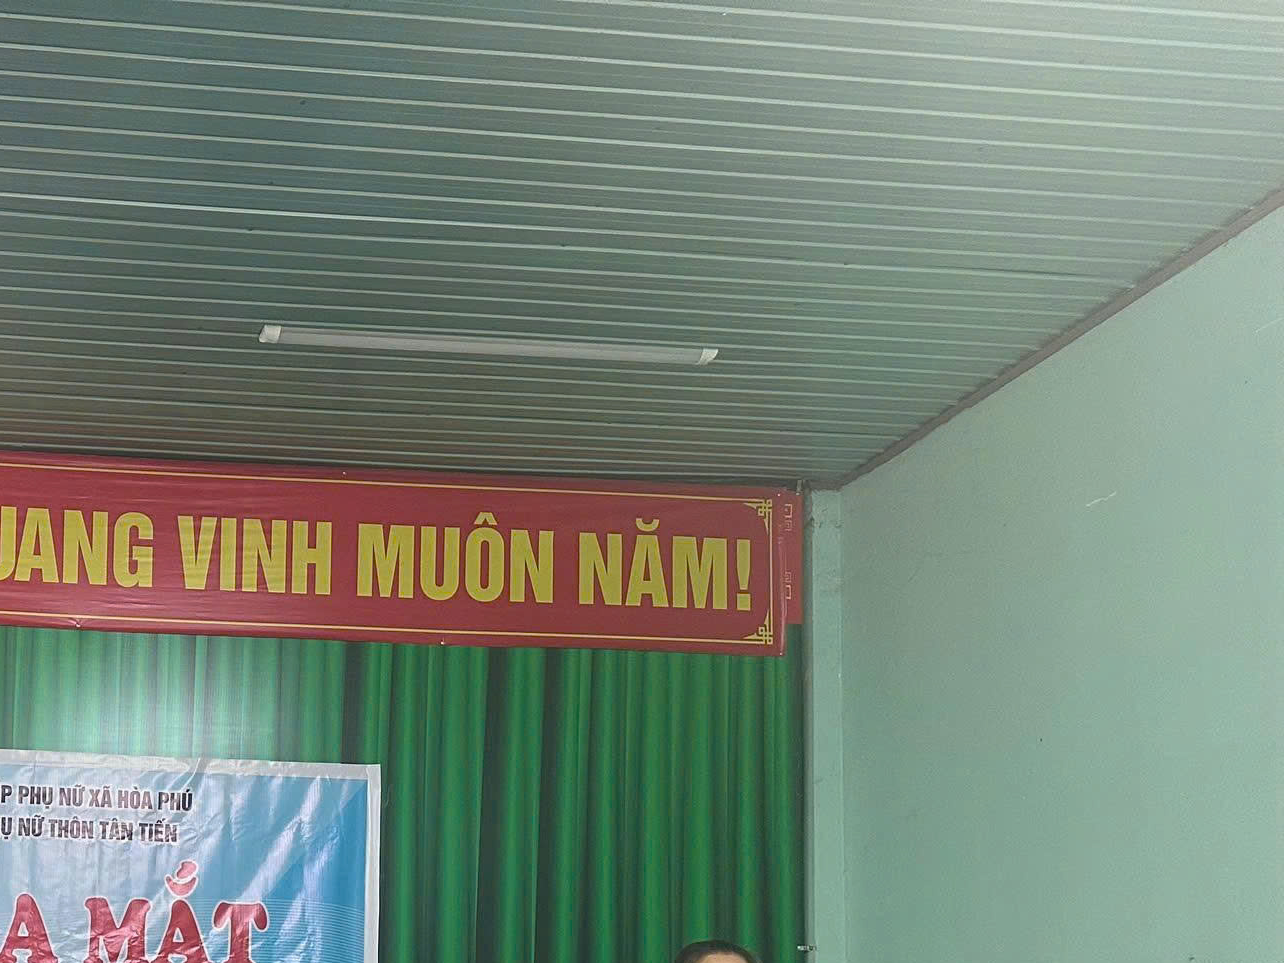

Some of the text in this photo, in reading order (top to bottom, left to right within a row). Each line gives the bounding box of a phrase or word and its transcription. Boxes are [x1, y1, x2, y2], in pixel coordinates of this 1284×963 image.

[178, 515, 333, 596] VINH
[357, 511, 555, 604] MUÔN
[579, 518, 752, 611] NĂM!
[18, 785, 53, 809] PHỤ
[59, 784, 85, 807] NỮ
[89, 786, 112, 808] XÃ
[117, 786, 153, 810] HÒA
[157, 788, 193, 812] PHÚ
[18, 815, 45, 837] NỮ
[48, 816, 94, 839] THÔN
[99, 818, 133, 841] TÂN
[139, 818, 178, 843] TIẾN
